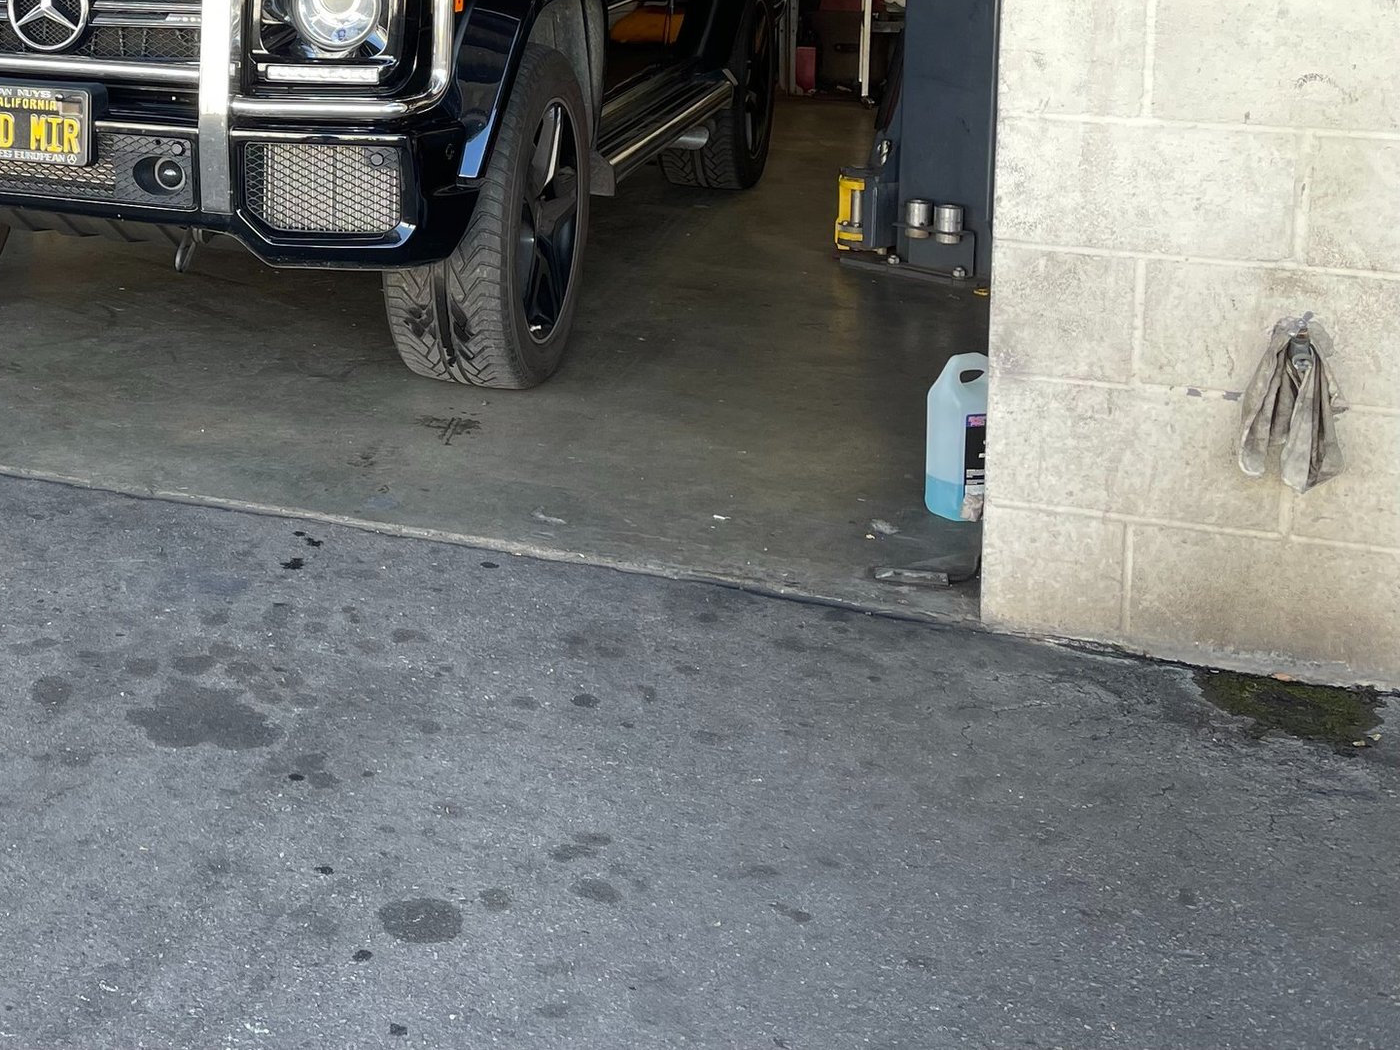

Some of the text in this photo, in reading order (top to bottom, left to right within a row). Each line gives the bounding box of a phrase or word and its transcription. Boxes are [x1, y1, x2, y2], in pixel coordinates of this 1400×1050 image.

[17, 89, 52, 98] NUYS
[29, 113, 81, 154] MIR
[14, 150, 66, 163] EUROPEAN
